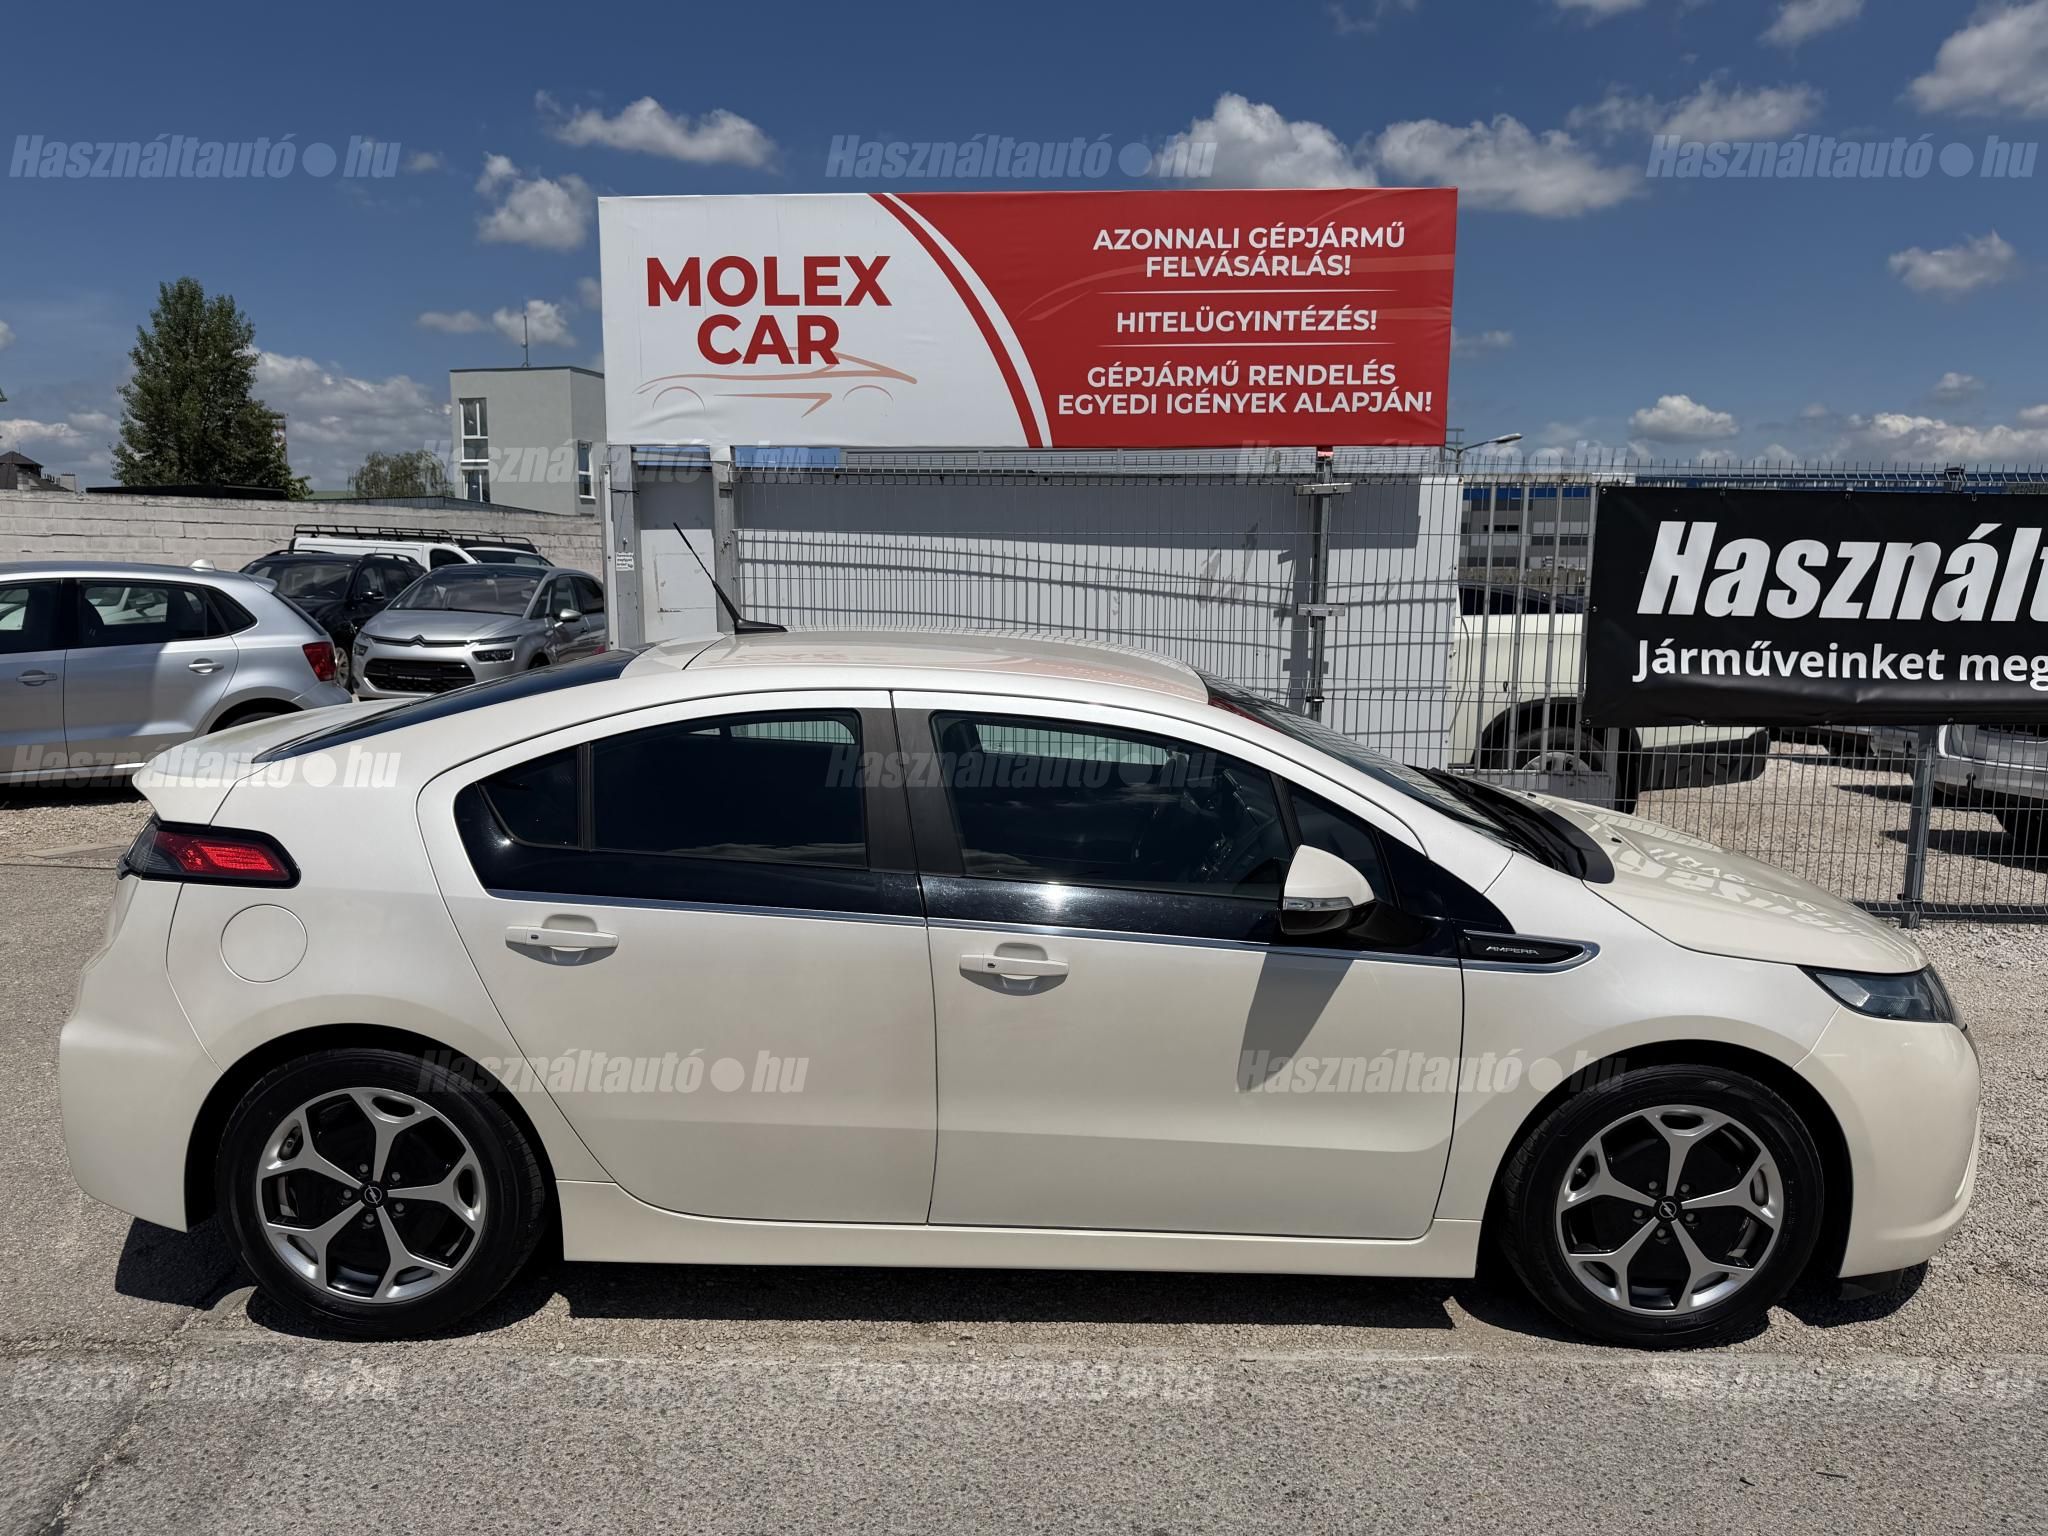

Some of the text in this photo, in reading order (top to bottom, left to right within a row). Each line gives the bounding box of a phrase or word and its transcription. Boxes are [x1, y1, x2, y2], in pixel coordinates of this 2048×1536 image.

[1093, 221, 1406, 251] AZONNALI GÉPJÁRMŰ
[1146, 250, 1351, 278] FELVÁSÁRLÁS!
[646, 255, 892, 307] MOLEX
[1116, 305, 1377, 334] HITELÜGYINTÉZÉS!
[697, 313, 841, 366] CAR
[1087, 359, 1396, 388] GÉPJÁRMŰ RENDELÉS
[1058, 387, 1433, 415] EGYEDI IGÉNYEK ALAPJÁN!
[1632, 638, 1946, 683] Járműveinket
